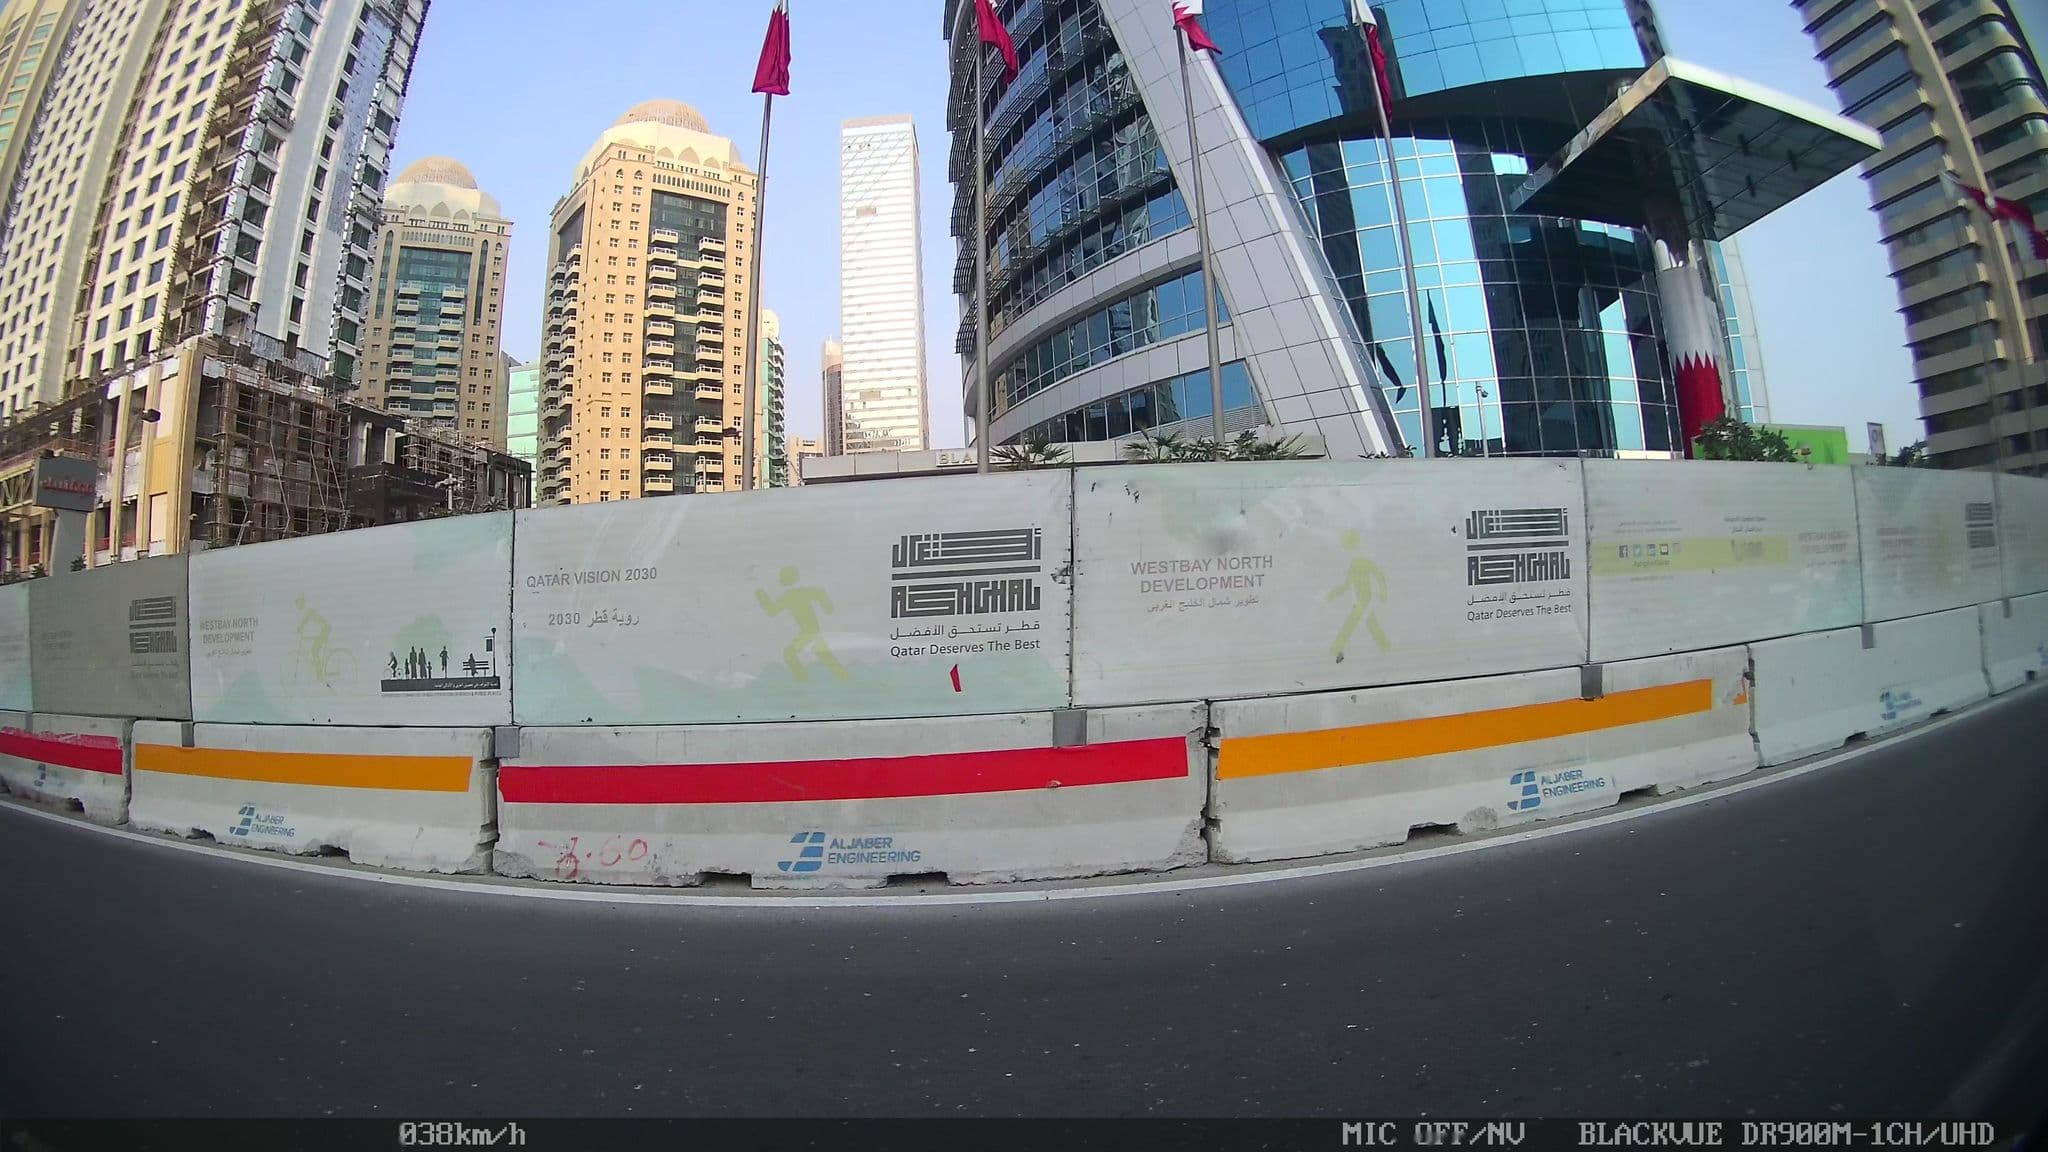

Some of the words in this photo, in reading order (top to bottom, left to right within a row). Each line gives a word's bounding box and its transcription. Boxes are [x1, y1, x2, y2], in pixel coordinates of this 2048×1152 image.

[1131, 558, 1212, 575] WESTBAY
[1217, 555, 1273, 571] NORTH
[1467, 552, 1570, 585] ASHGHAL
[526, 573, 570, 588] QATAR
[574, 570, 621, 584] VISION
[625, 567, 657, 581] 2030
[1140, 574, 1265, 593] DEVELOPMENT
[891, 579, 1041, 618] ASHGHAL
[548, 612, 580, 626] 2030
[588, 609, 609, 628] قطر
[1467, 611, 1493, 622] Qatar
[1496, 607, 1534, 618] Deserves
[1536, 605, 1552, 615] The
[1554, 604, 1571, 613] Best
[948, 623, 1002, 638] تستحق
[1005, 621, 1040, 634] قطر
[890, 646, 926, 657] Qatar
[929, 643, 984, 655] Deserves
[987, 640, 1010, 651] The
[1015, 639, 1041, 650] Best
[1543, 777, 1605, 798] ENGINEERING
[828, 850, 921, 864] ENGINEERING
